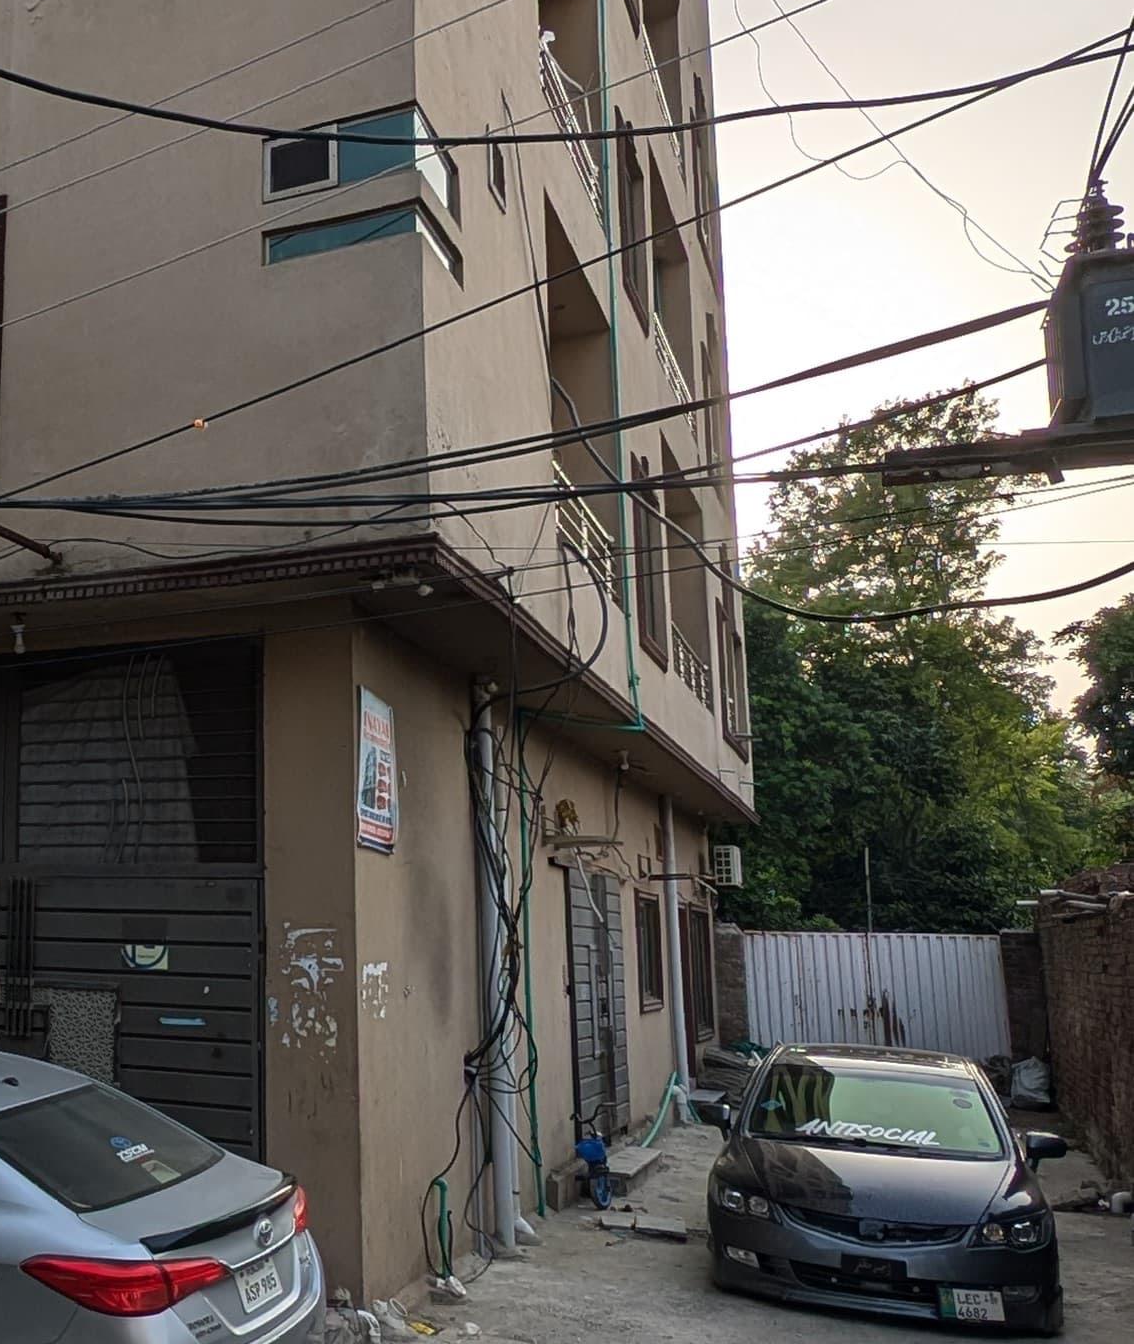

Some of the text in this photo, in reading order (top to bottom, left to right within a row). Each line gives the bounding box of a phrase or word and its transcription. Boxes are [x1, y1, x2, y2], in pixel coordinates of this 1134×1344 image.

[795, 1118, 940, 1147] ANTISOCIAL
[957, 1293, 981, 1305] LEC
[958, 1306, 988, 1320] 4682
